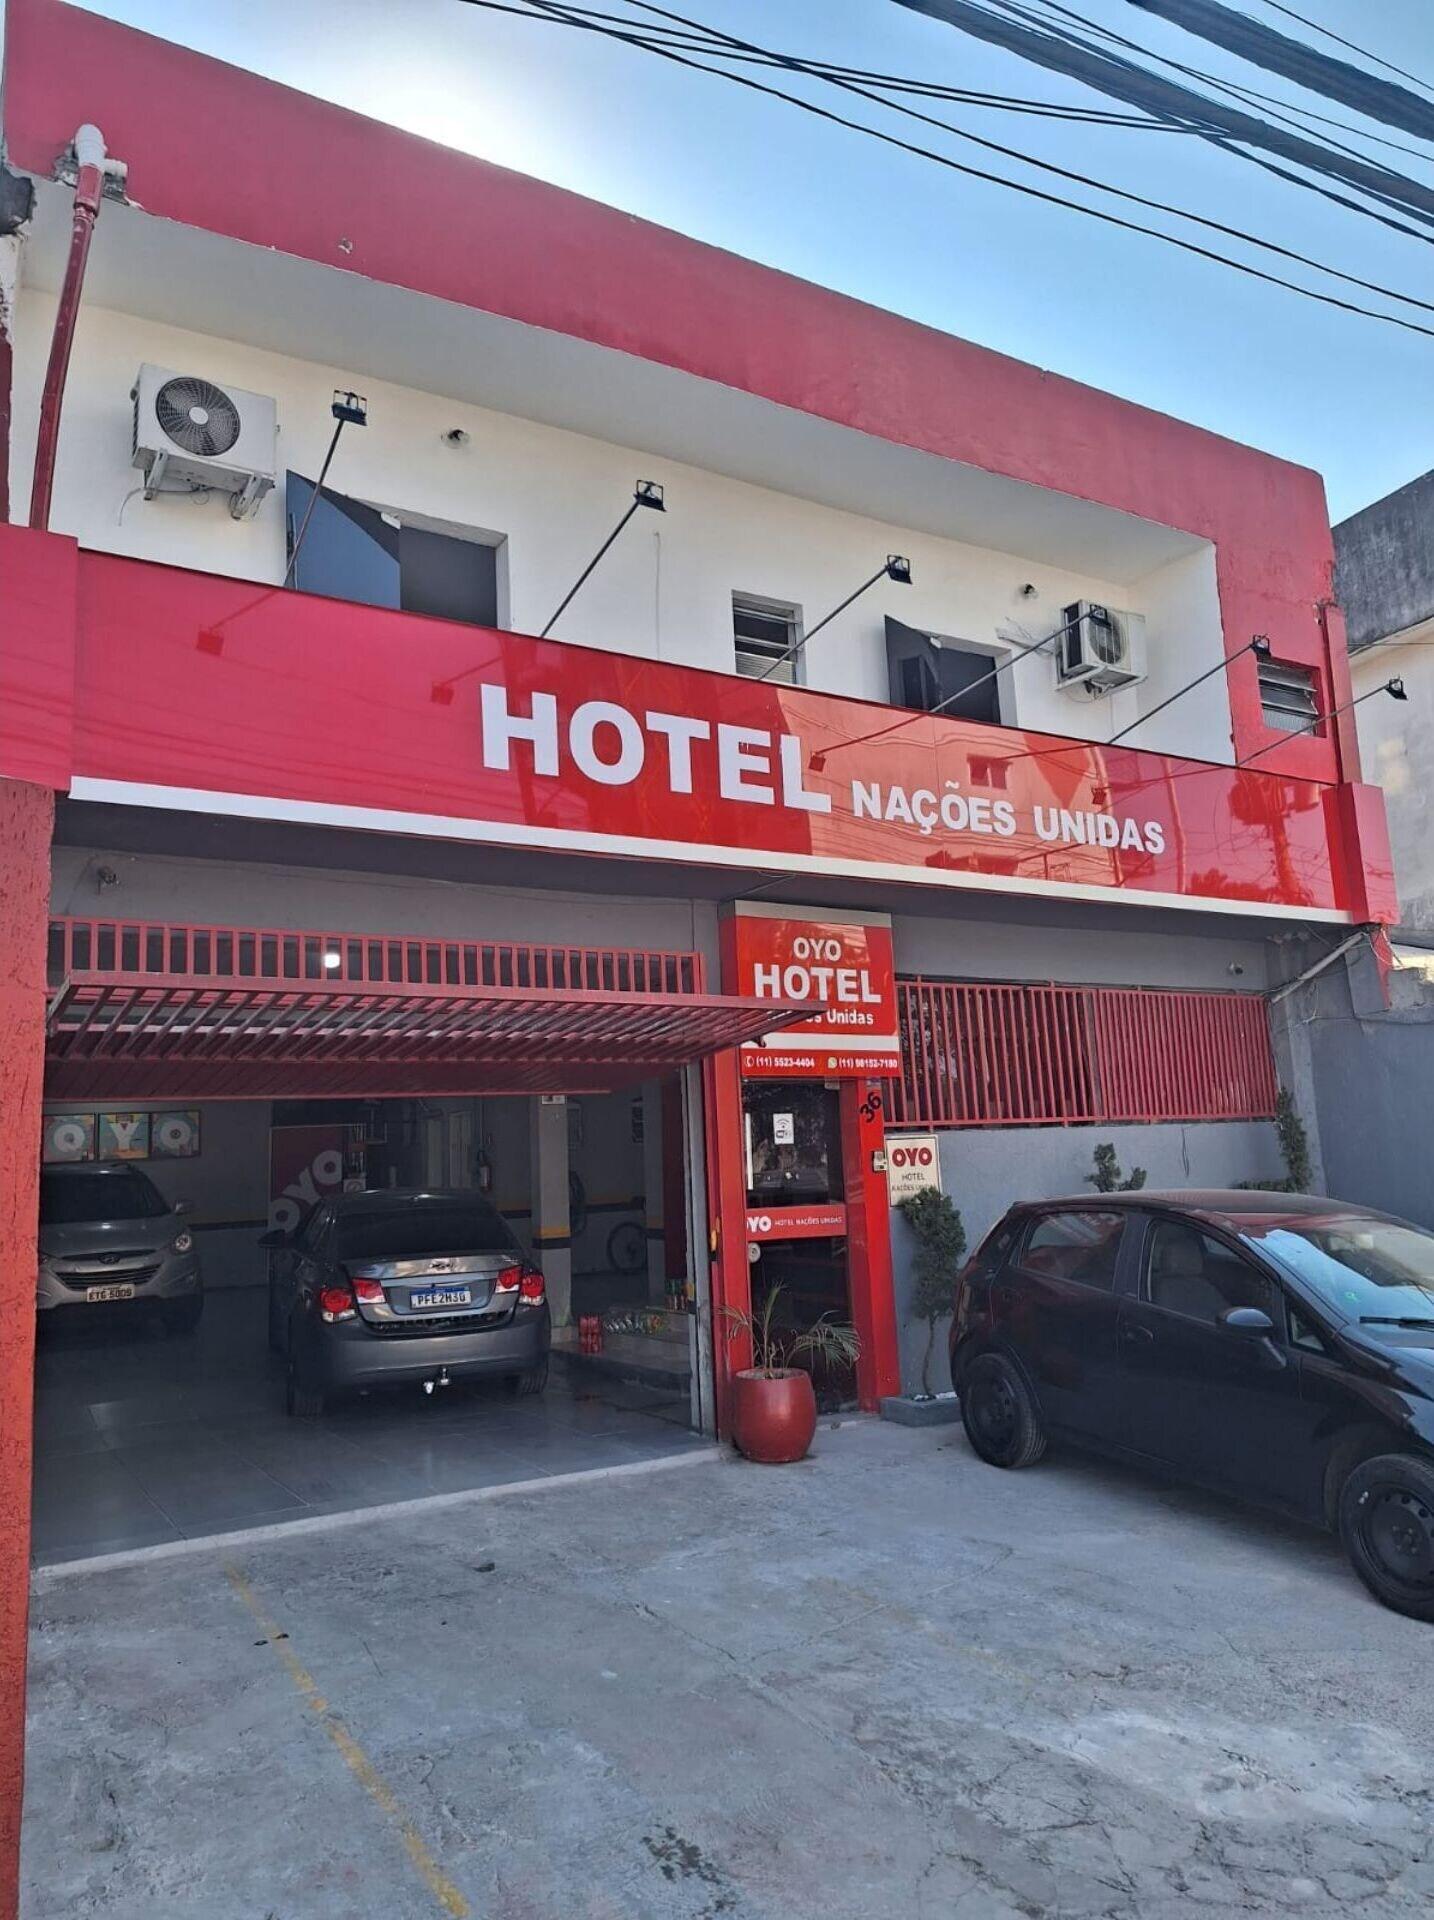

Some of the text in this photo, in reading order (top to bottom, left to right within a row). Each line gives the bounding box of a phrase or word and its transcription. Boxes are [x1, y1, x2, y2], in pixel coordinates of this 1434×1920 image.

[480, 683, 832, 813] HOTEL
[851, 779, 1166, 856] NAÇÕES UNIDAS
[793, 936, 842, 962] OYO
[753, 962, 882, 1004] HOTEL
[826, 1008, 874, 1026] Unidas
[756, 1055, 772, 1067] (11)
[838, 1057, 854, 1069] (11)
[860, 1091, 882, 1123] 36
[892, 1146, 933, 1168] OYO
[902, 1172, 925, 1181] HOTEL
